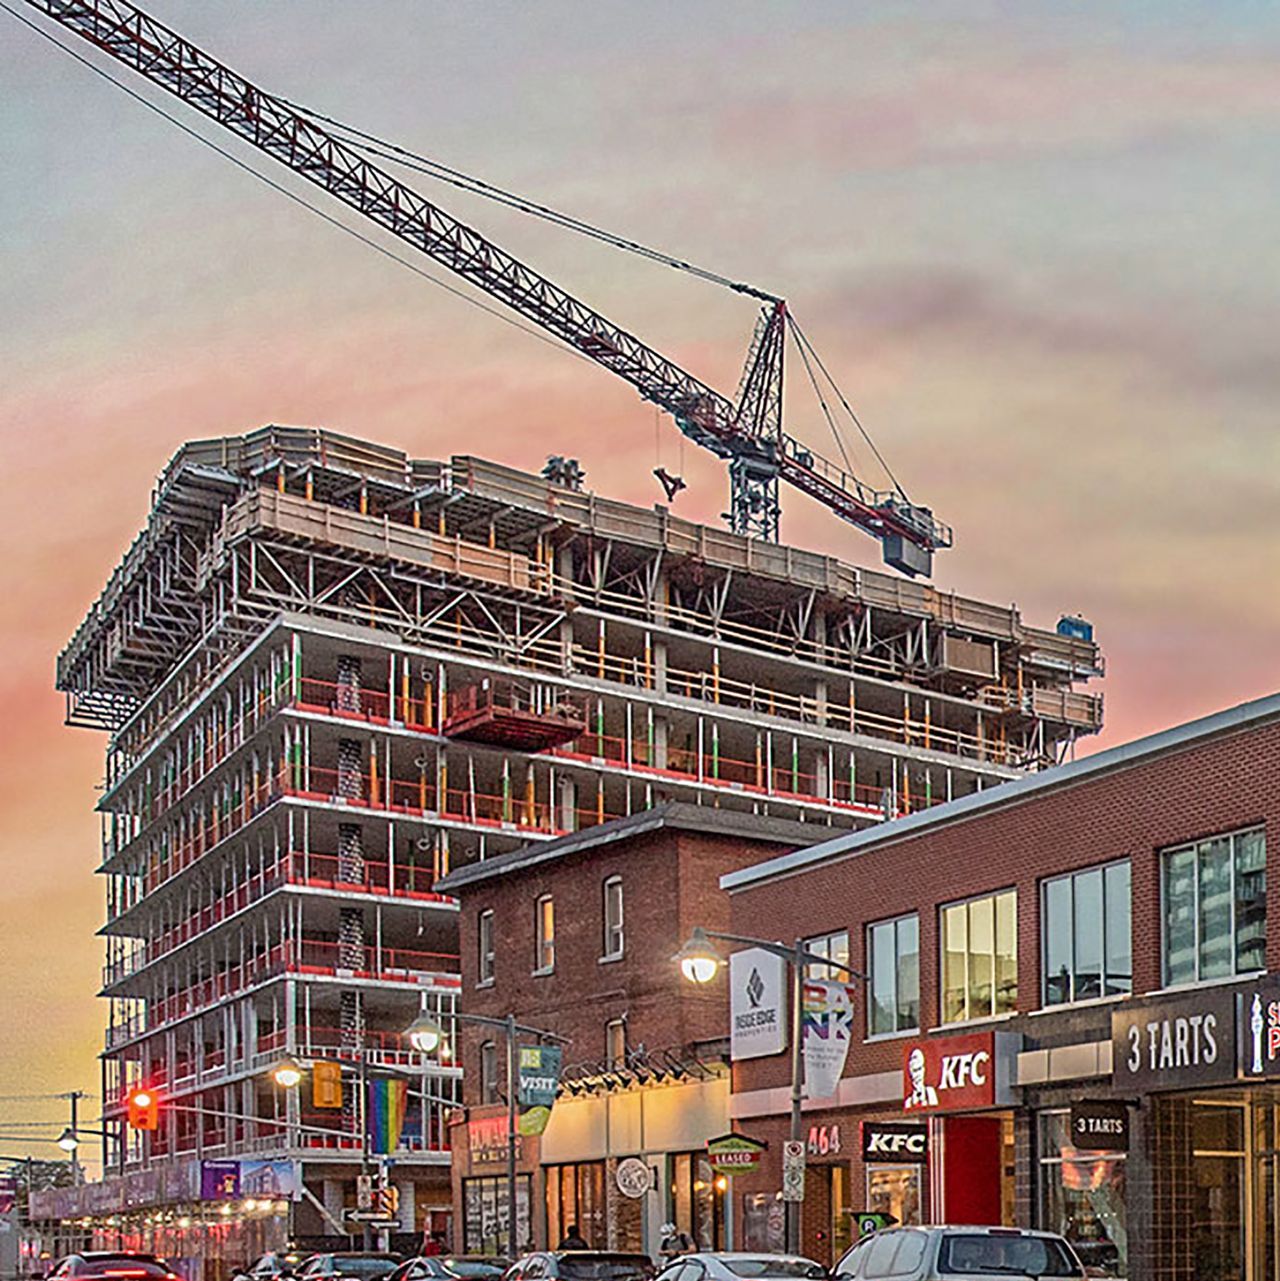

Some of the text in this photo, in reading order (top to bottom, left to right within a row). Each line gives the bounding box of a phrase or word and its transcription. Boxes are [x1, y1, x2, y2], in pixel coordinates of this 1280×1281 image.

[1127, 1013, 1217, 1073] 3 TARTS
[938, 1050, 990, 1091] KFC
[519, 1075, 556, 1092] VISIT
[1076, 1117, 1125, 1134] 3 TARTS
[808, 1125, 841, 1156] 464
[867, 1133, 926, 1154] KFC
[715, 1152, 752, 1165] LEASED
